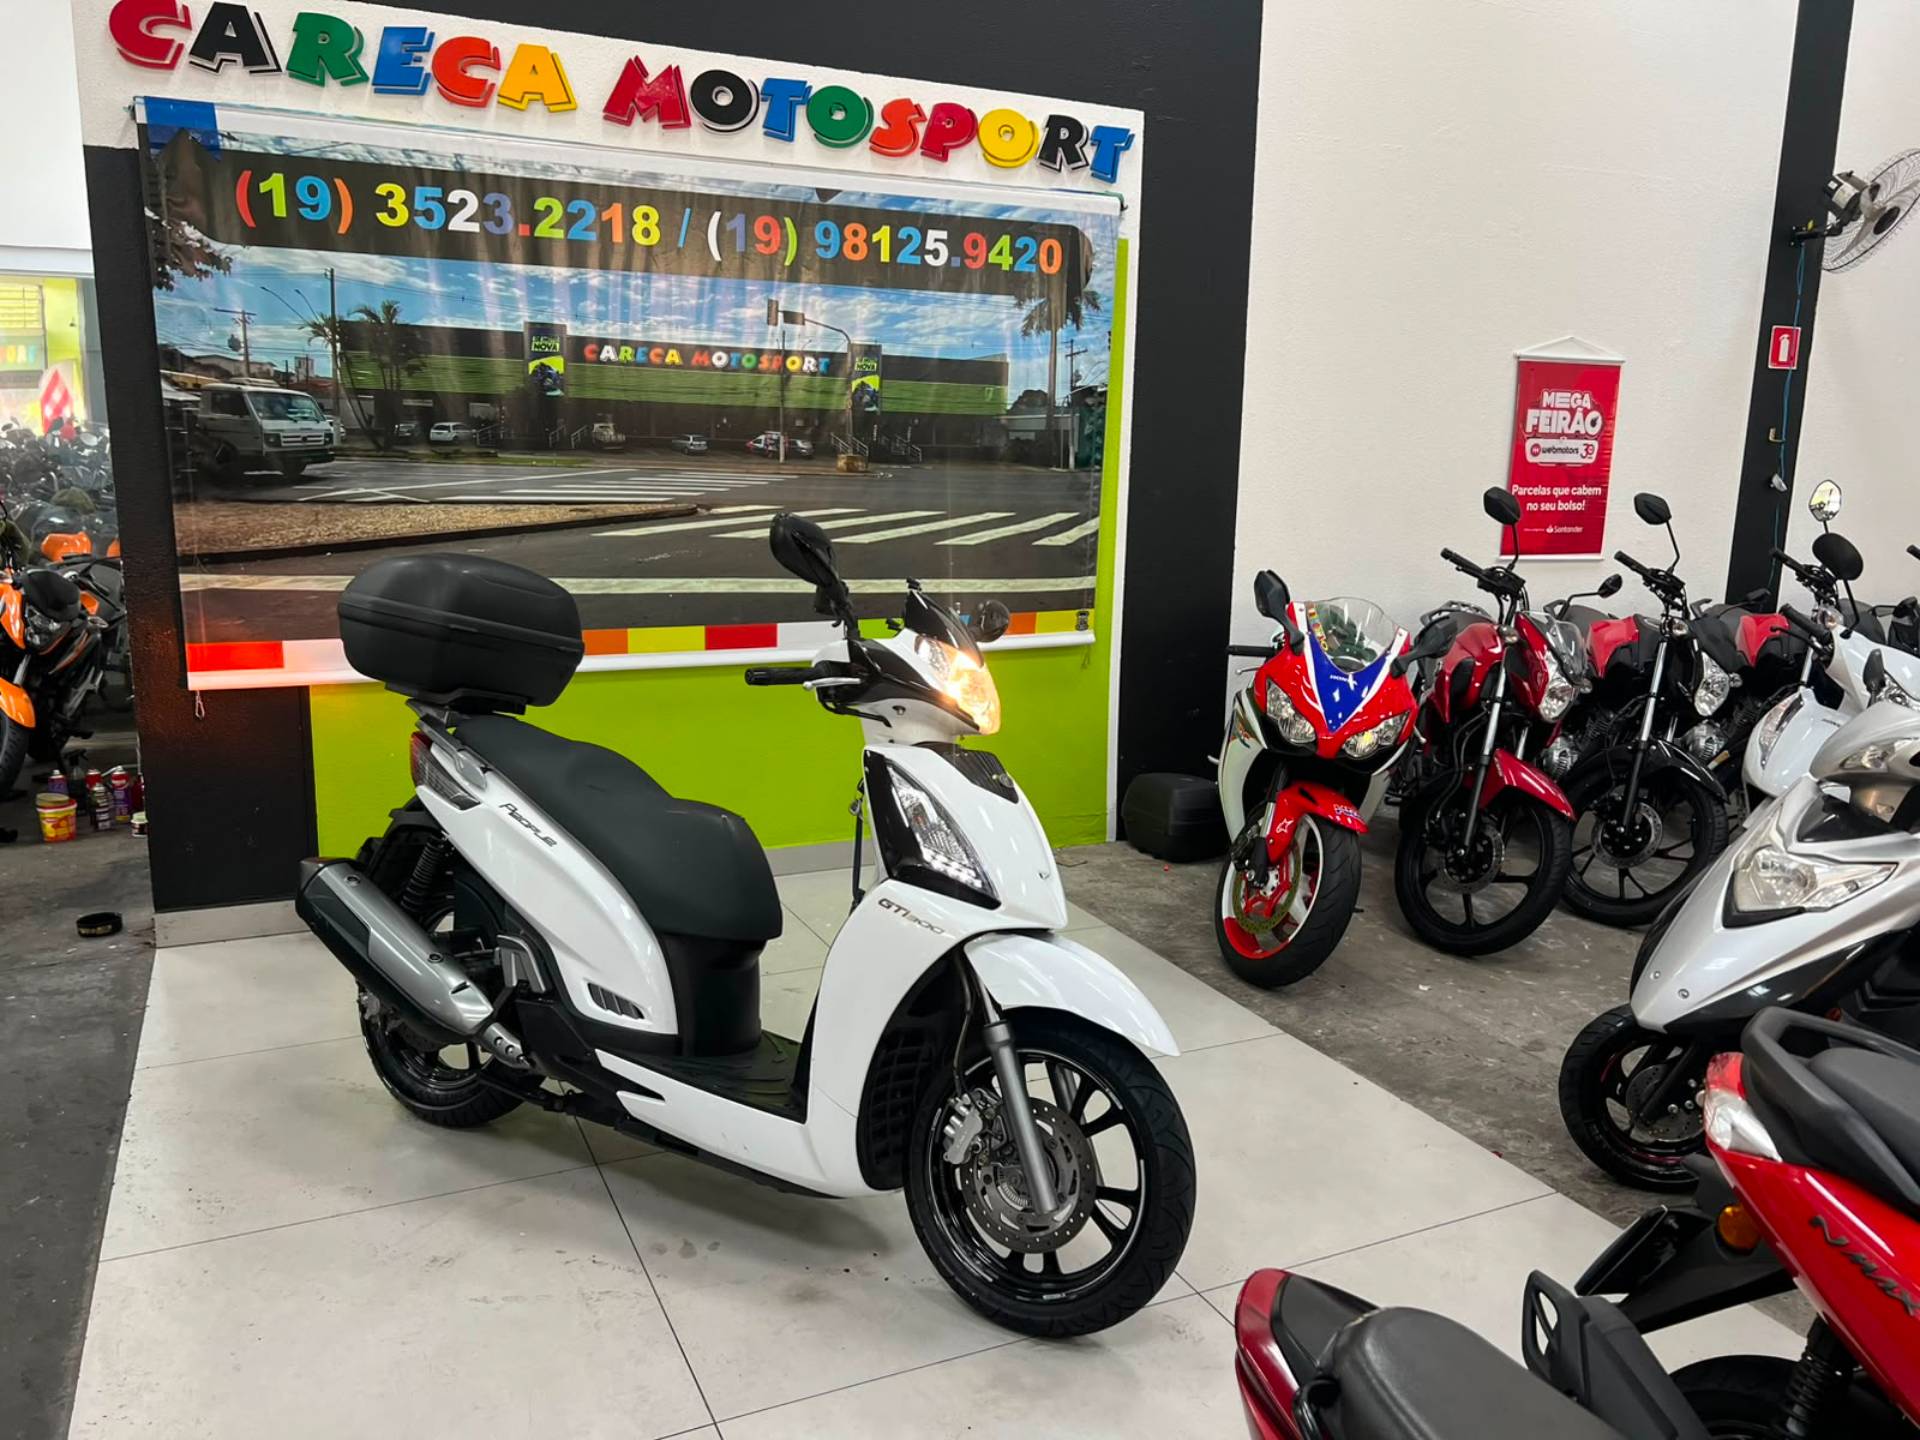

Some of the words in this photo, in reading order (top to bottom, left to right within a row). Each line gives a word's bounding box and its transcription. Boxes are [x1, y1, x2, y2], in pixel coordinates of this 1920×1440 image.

[108, 0, 577, 112] CARECA
[602, 55, 1134, 184] MOTOSPORT
[236, 169, 353, 235] (19)
[375, 182, 661, 246] 3523.2218
[707, 210, 798, 267] (19)
[814, 219, 1063, 274] 98125.9420
[583, 344, 683, 365] CARECA
[691, 350, 831, 375] MOTOSPORT
[1542, 391, 1591, 409] MEGA
[1525, 407, 1602, 436] FEIRÃO
[1541, 445, 1579, 454] webmotors
[1511, 484, 1551, 495] Parcelas
[1552, 487, 1569, 498] que
[1571, 484, 1602, 495] cabem
[1526, 502, 1538, 511] no
[1540, 502, 1556, 511] seu
[1557, 500, 1586, 511] bolso!
